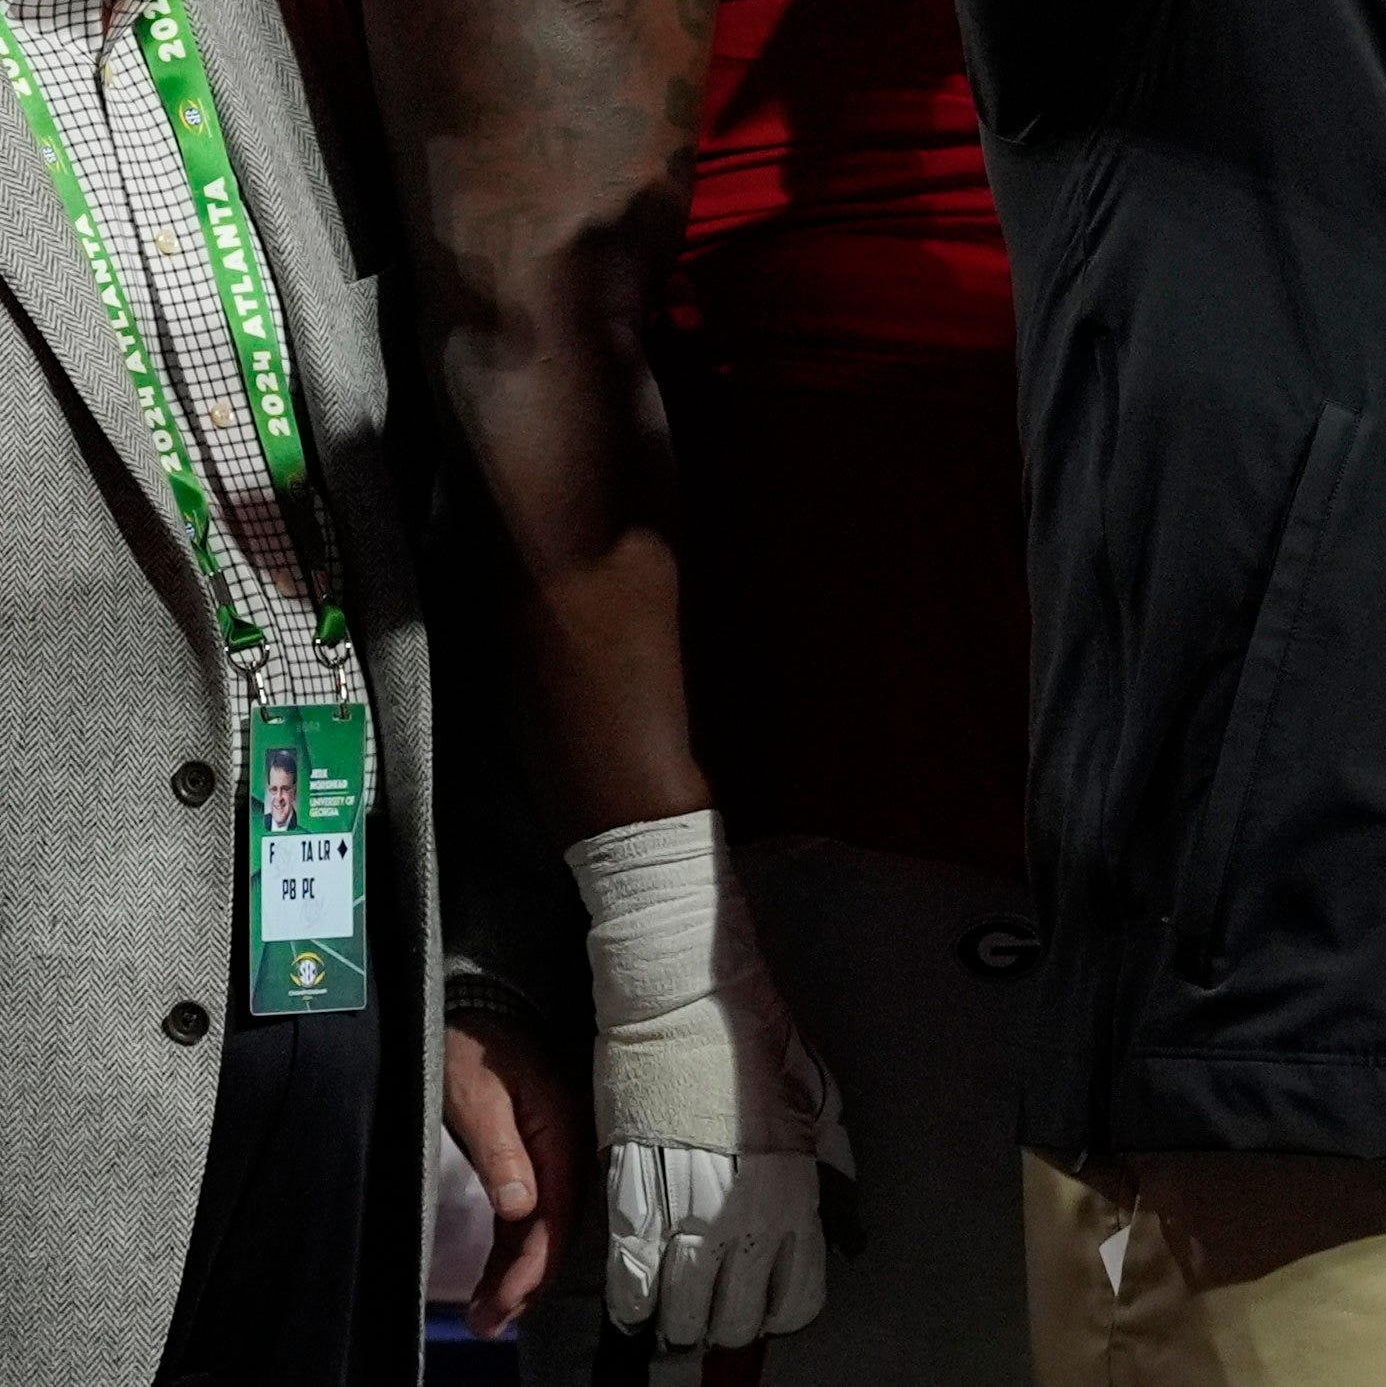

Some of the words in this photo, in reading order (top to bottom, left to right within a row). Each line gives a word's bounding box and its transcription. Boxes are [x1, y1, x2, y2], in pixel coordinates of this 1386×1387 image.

[73, 211, 148, 376] ATLANTA
[202, 174, 268, 340] ATLANTA
[143, 394, 182, 474] 2024
[252, 349, 291, 438] 2024
[282, 878, 297, 901] PB
[302, 877, 315, 900] PC
[302, 840, 313, 863] TA
[318, 839, 331, 862] LR
